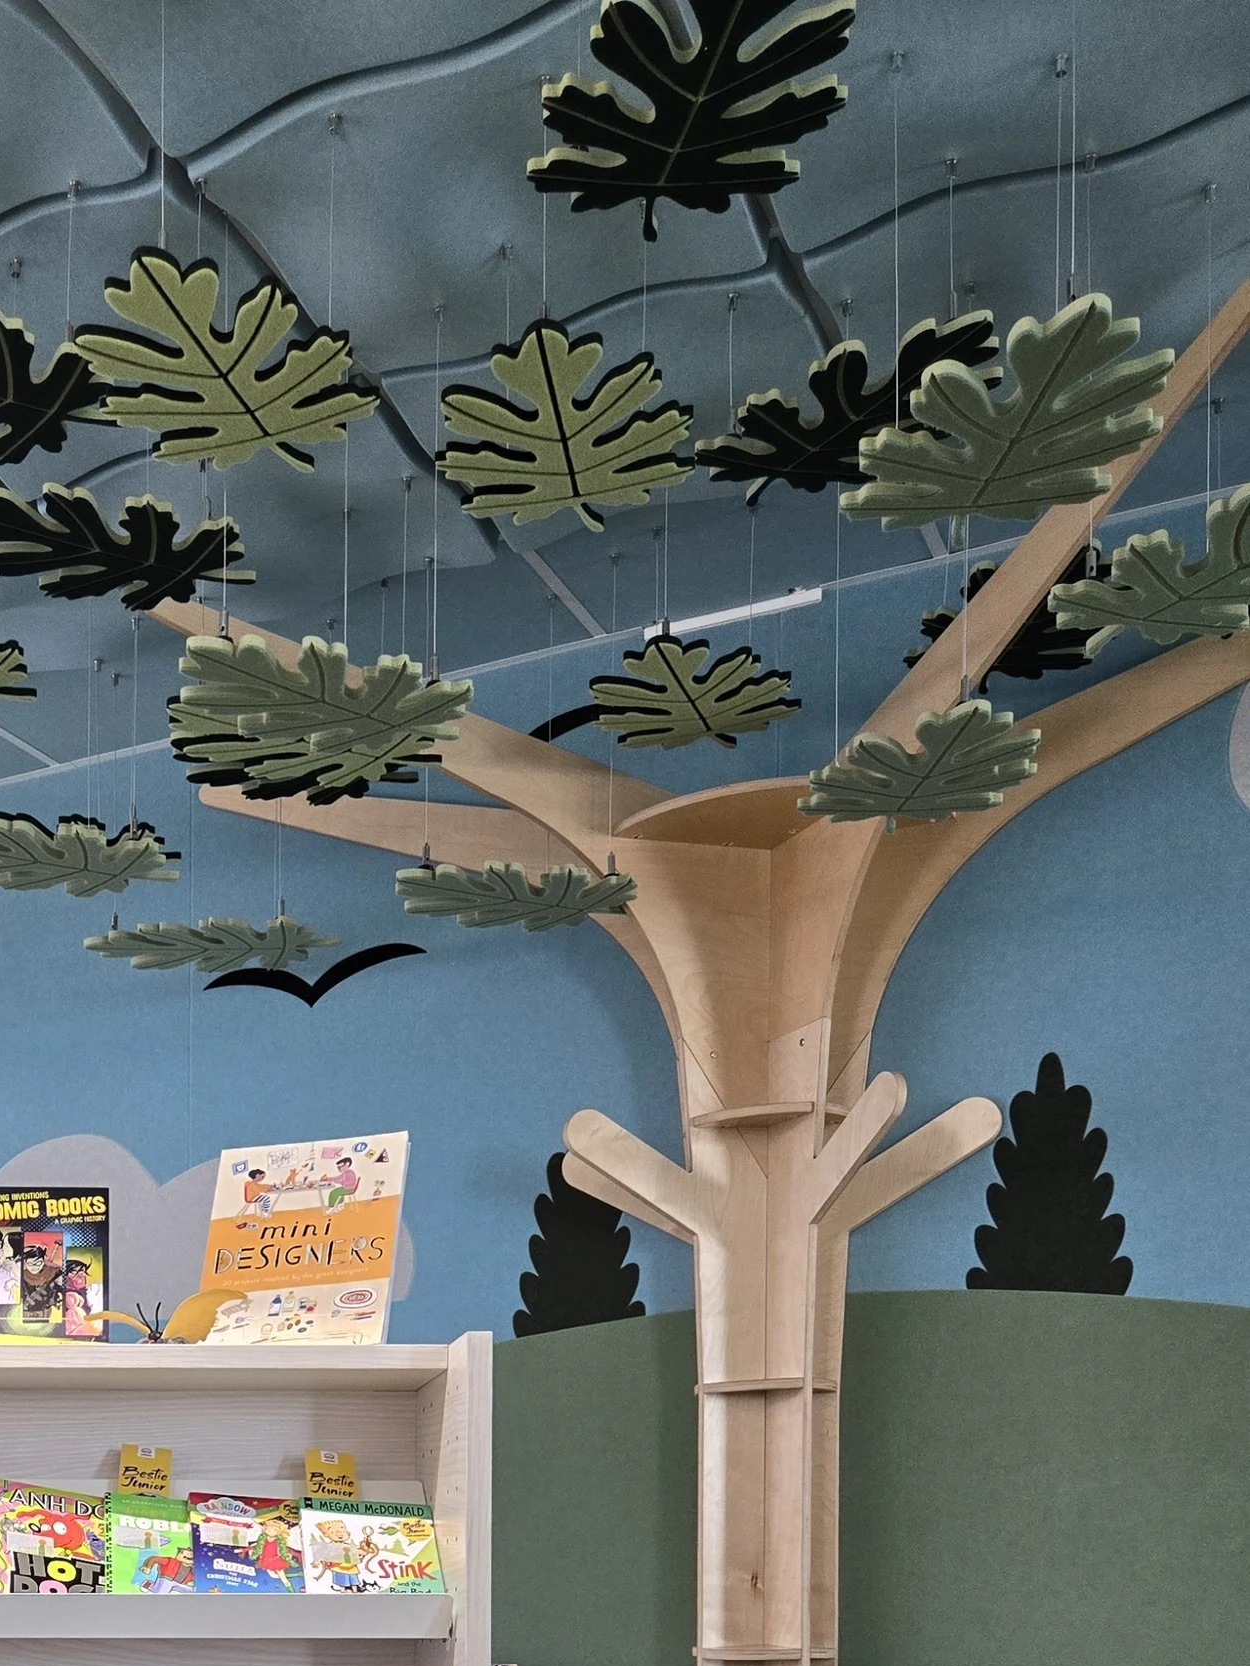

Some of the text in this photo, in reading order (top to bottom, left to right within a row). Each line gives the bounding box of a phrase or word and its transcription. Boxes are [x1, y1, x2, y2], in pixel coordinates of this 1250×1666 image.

[11, 1191, 49, 1201] INVENTIONS
[46, 1195, 107, 1217] BOOKS
[259, 1218, 332, 1240] mini
[214, 1236, 386, 1275] DESIGNERS
[123, 1466, 168, 1482] Bestie
[309, 1472, 355, 1488] Bestie
[121, 1477, 167, 1492] Junior
[310, 1482, 355, 1499] Junior
[10, 1488, 65, 1513] ANH
[319, 1501, 425, 1517] MEGAN McDONALD
[16, 1551, 105, 1585] HOT
